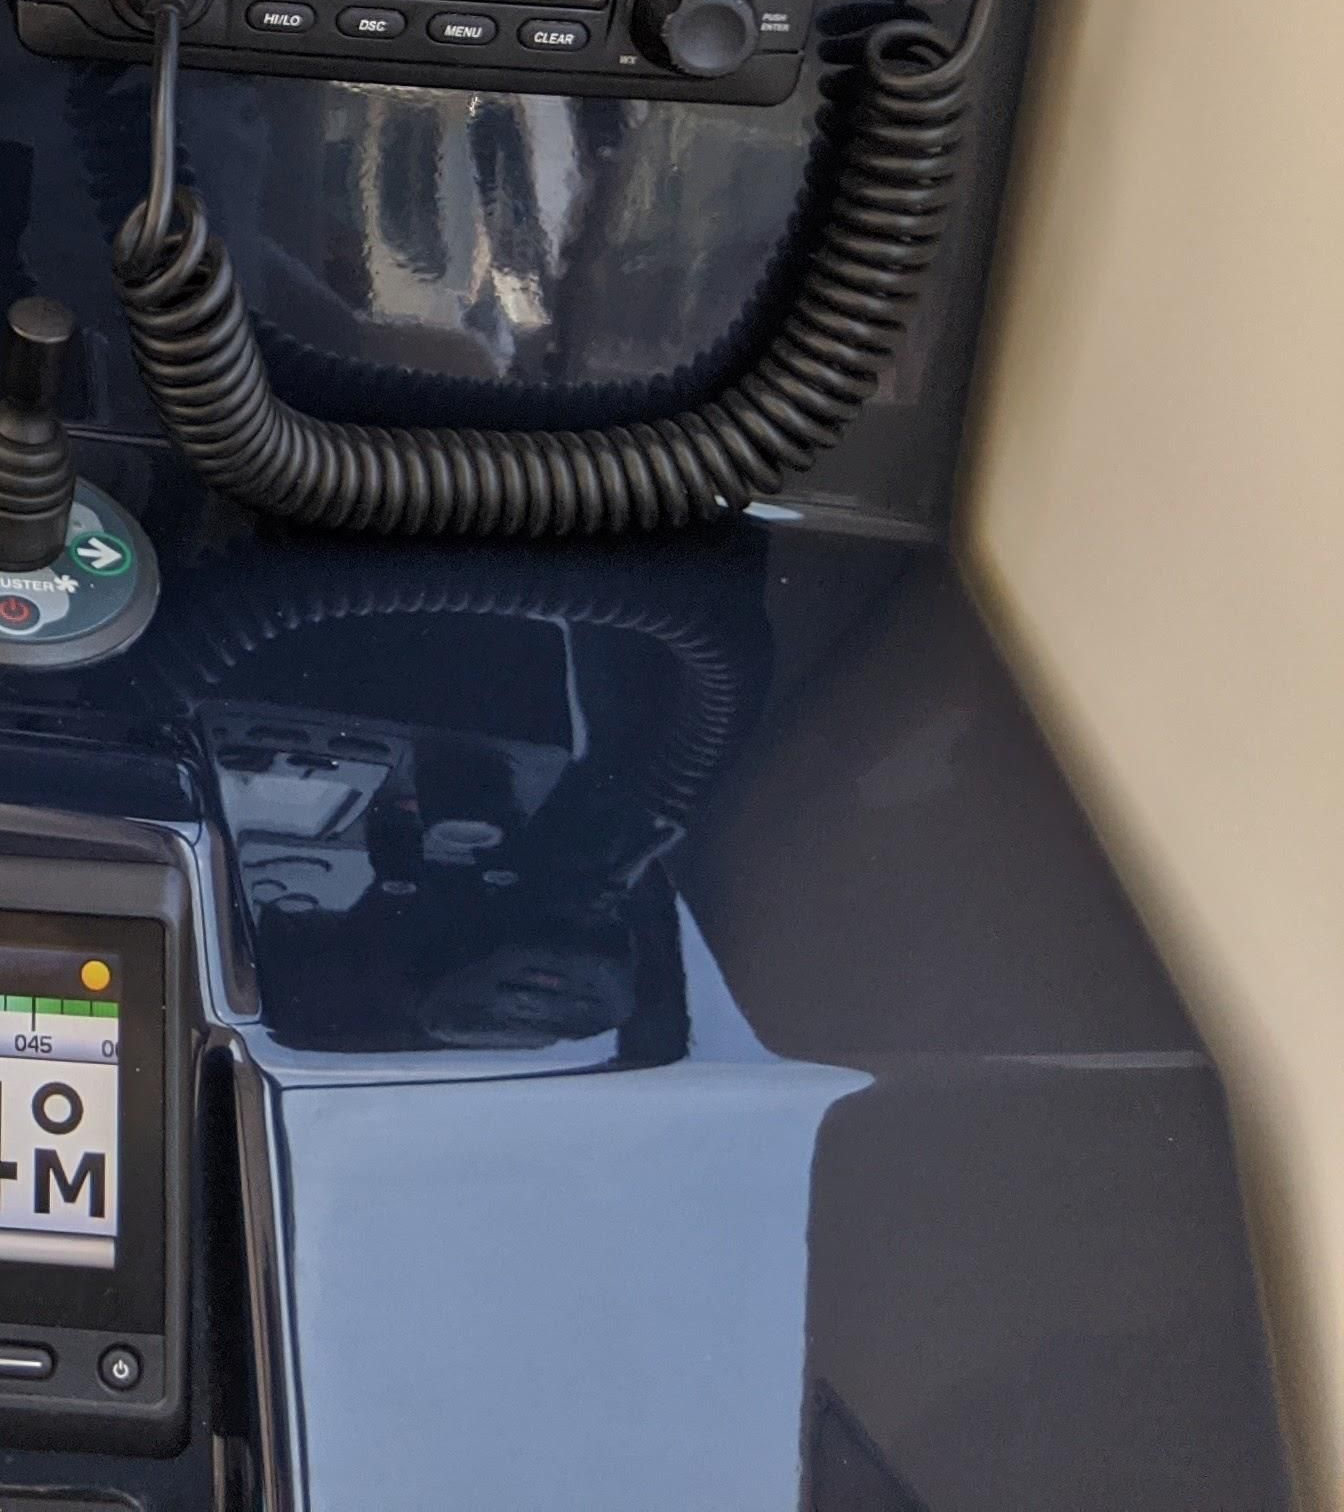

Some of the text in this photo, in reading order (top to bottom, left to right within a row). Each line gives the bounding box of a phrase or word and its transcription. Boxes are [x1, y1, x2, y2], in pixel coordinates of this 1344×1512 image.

[264, 13, 303, 27] HI/LO
[359, 19, 388, 33] DSC
[444, 25, 483, 39] MENU
[534, 32, 576, 45] CLEAR
[14, 1033, 54, 1056] 045
